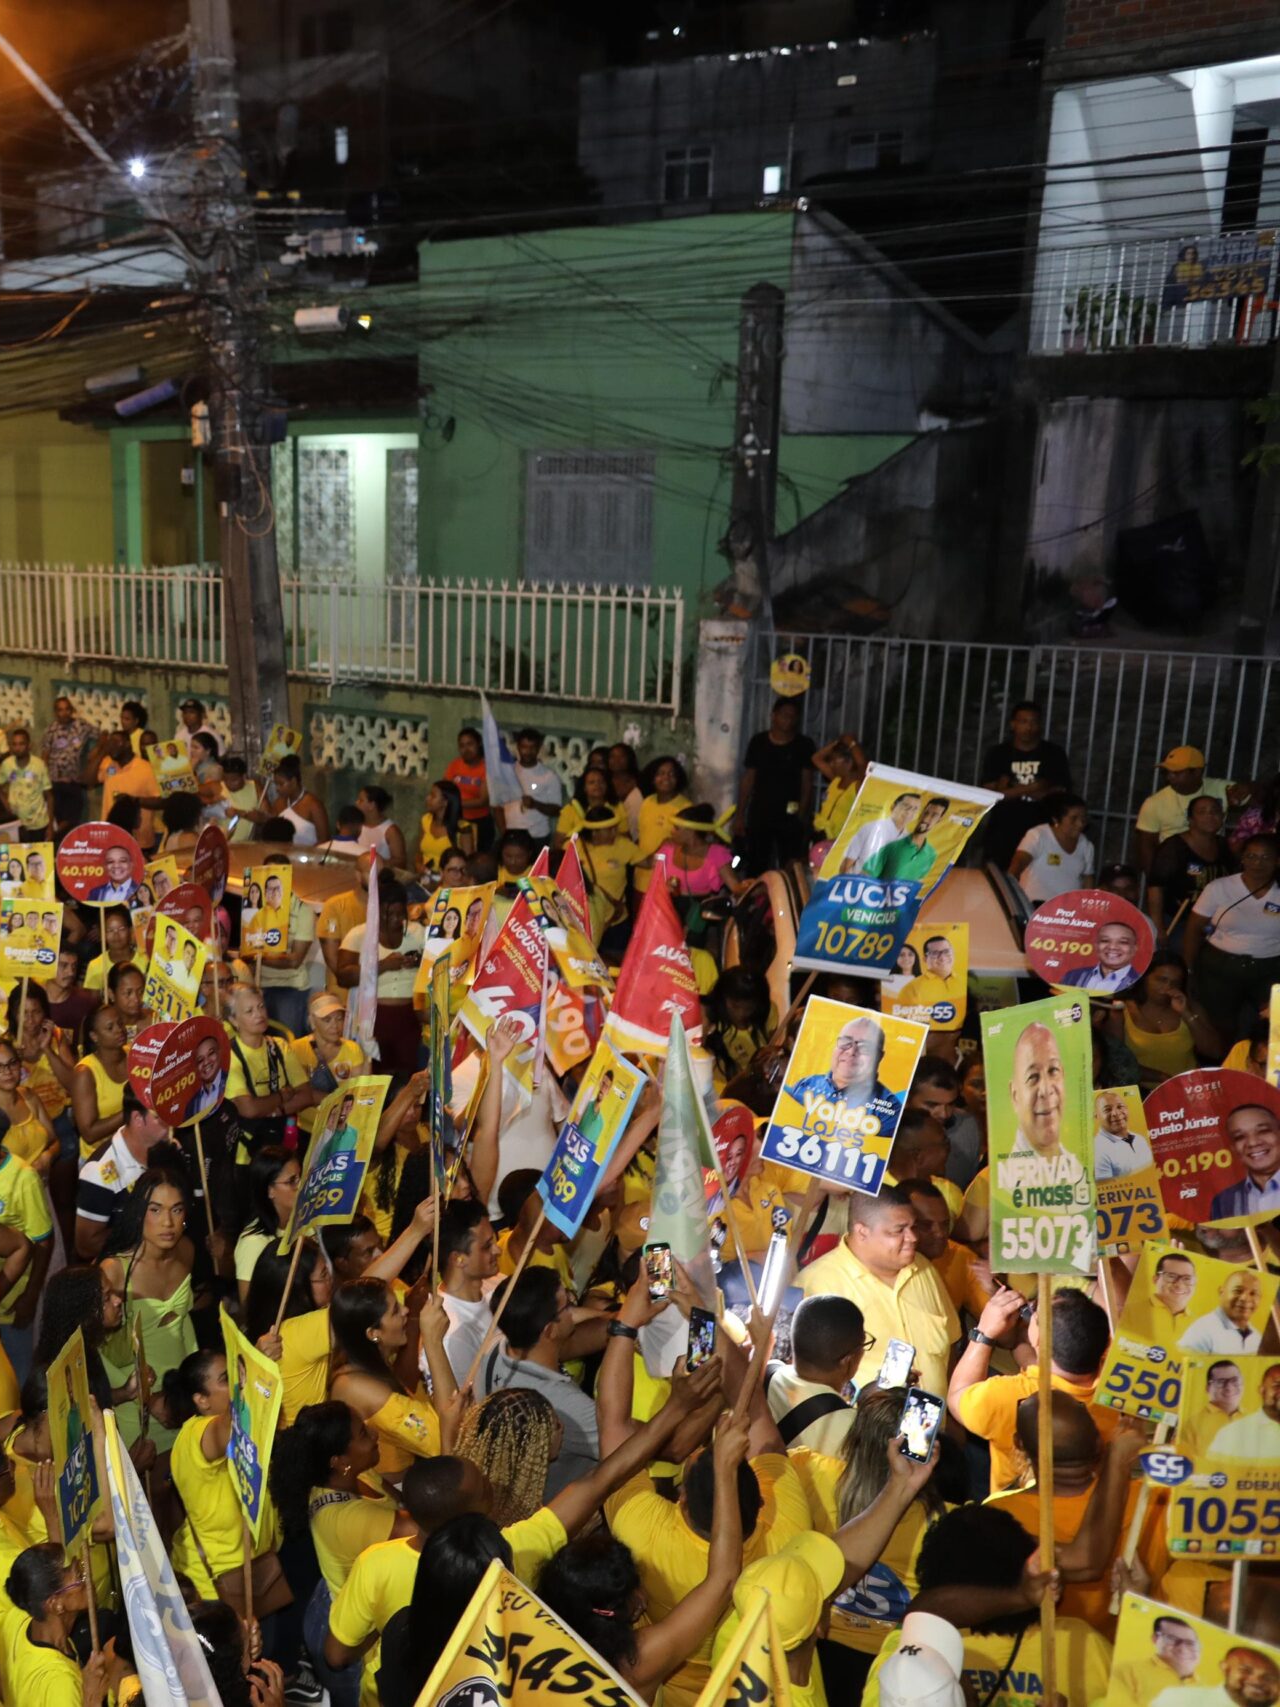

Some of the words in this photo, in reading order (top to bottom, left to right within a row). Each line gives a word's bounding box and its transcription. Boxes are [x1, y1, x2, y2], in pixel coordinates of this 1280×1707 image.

[61, 865, 104, 877] 40.190
[828, 880, 911, 908] LUCAS
[846, 908, 897, 924] VENICIUS
[1033, 914, 1070, 929] Augusto
[1055, 908, 1077, 918] Prof
[266, 931, 280, 944] 55
[814, 921, 894, 960] 10789
[1029, 937, 1094, 957] 40.190
[37, 950, 55, 963] 55
[932, 1005, 954, 1020] 55
[156, 1071, 196, 1106] 40.190
[1184, 1080, 1222, 1095] VOTE!
[803, 1091, 883, 1138] Valdo
[1159, 1108, 1185, 1123] Prof
[801, 1114, 866, 1148] Lajes
[1148, 1121, 1183, 1140] gusto
[1184, 1116, 1219, 1132] Júnior
[1012, 1179, 1023, 1208] é
[1097, 1186, 1156, 1206] ERIVAL
[1180, 1188, 1199, 1199] PSB
[1097, 1202, 1164, 1241] 073
[1001, 1214, 1090, 1261] 55073
[1147, 1347, 1166, 1361] 55
[1105, 1361, 1181, 1408] 550
[1147, 1453, 1185, 1479] 55
[1209, 1474, 1227, 1488] 55
[1177, 1496, 1280, 1536] 1055
[963, 1668, 1045, 1696] ERIVA
